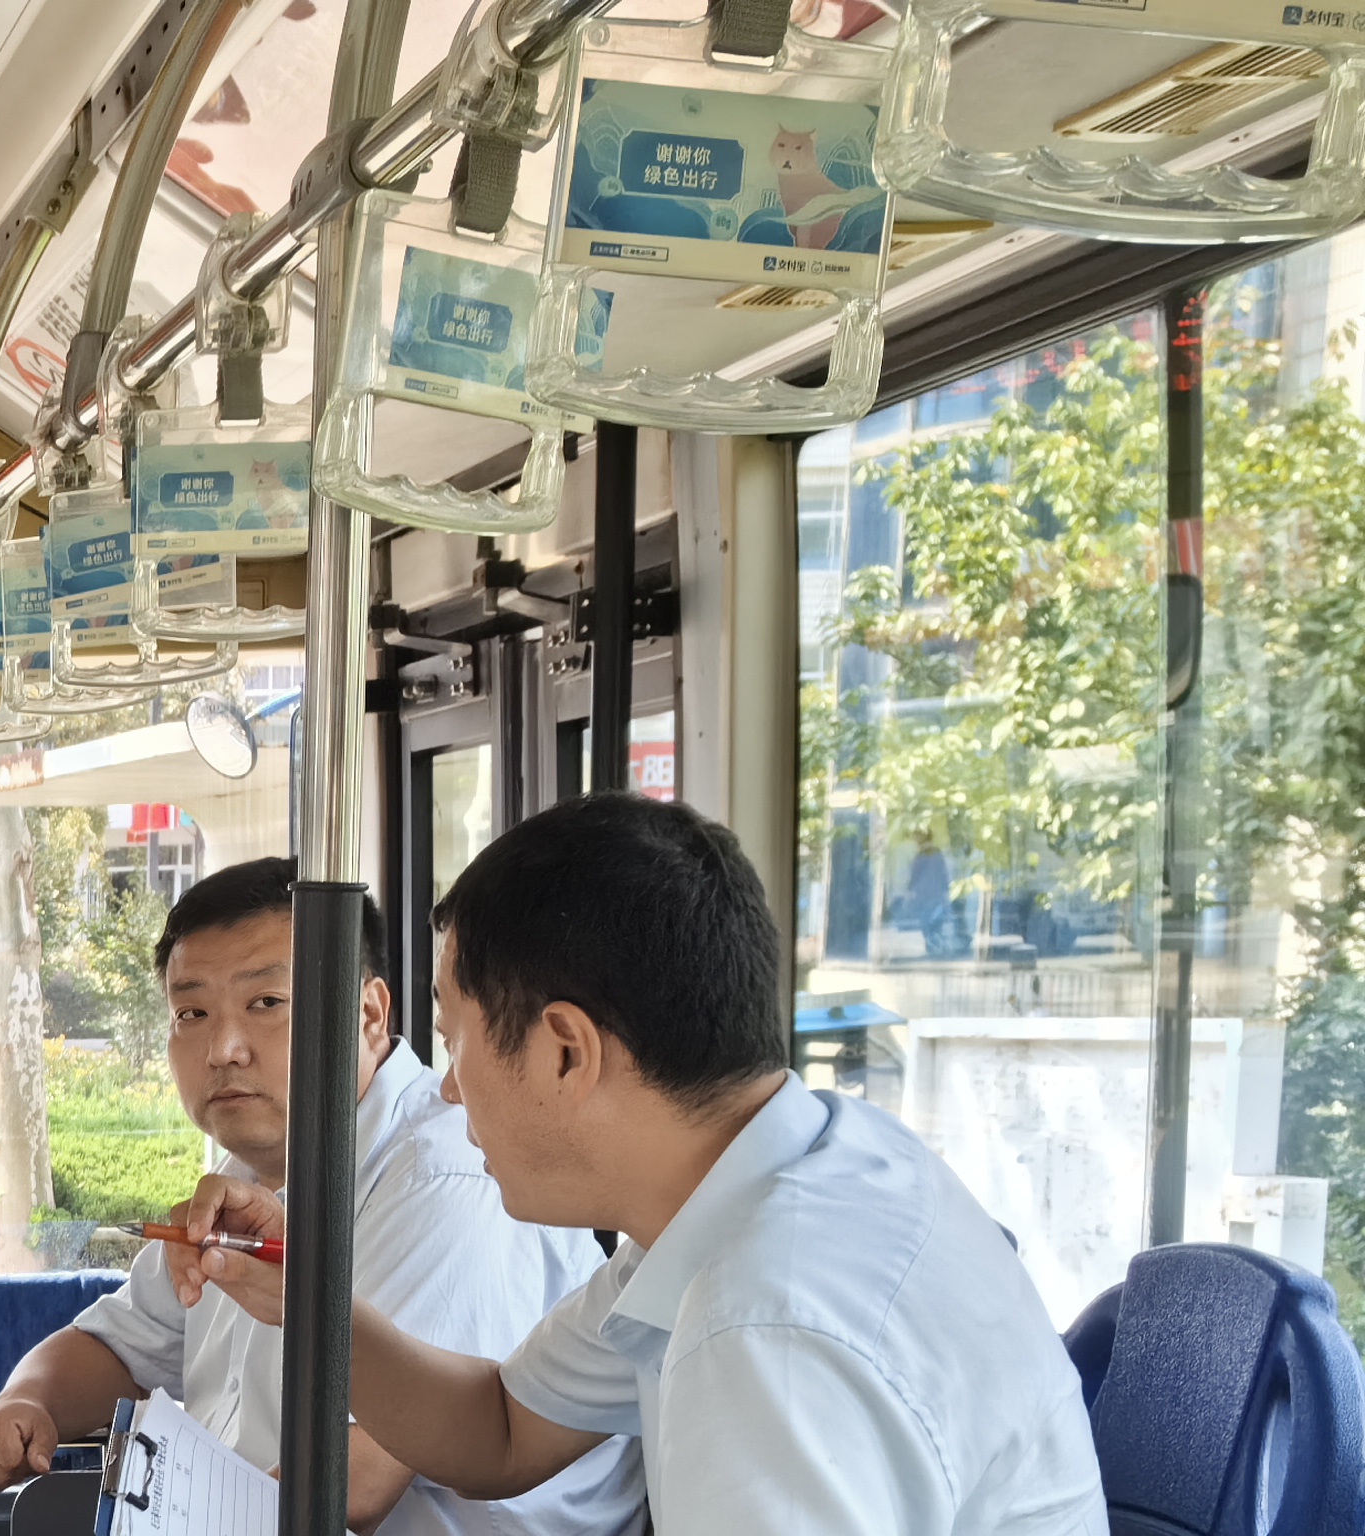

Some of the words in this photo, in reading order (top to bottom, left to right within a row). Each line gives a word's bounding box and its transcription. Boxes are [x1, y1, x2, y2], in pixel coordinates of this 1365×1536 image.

[656, 142, 711, 166] 谢谢你
[644, 164, 718, 191] 绿色出行
[453, 303, 491, 324] 谢谢你
[442, 320, 494, 346] 绿色出行
[180, 477, 215, 490] 谢谢你
[174, 491, 220, 504] 绿色出行
